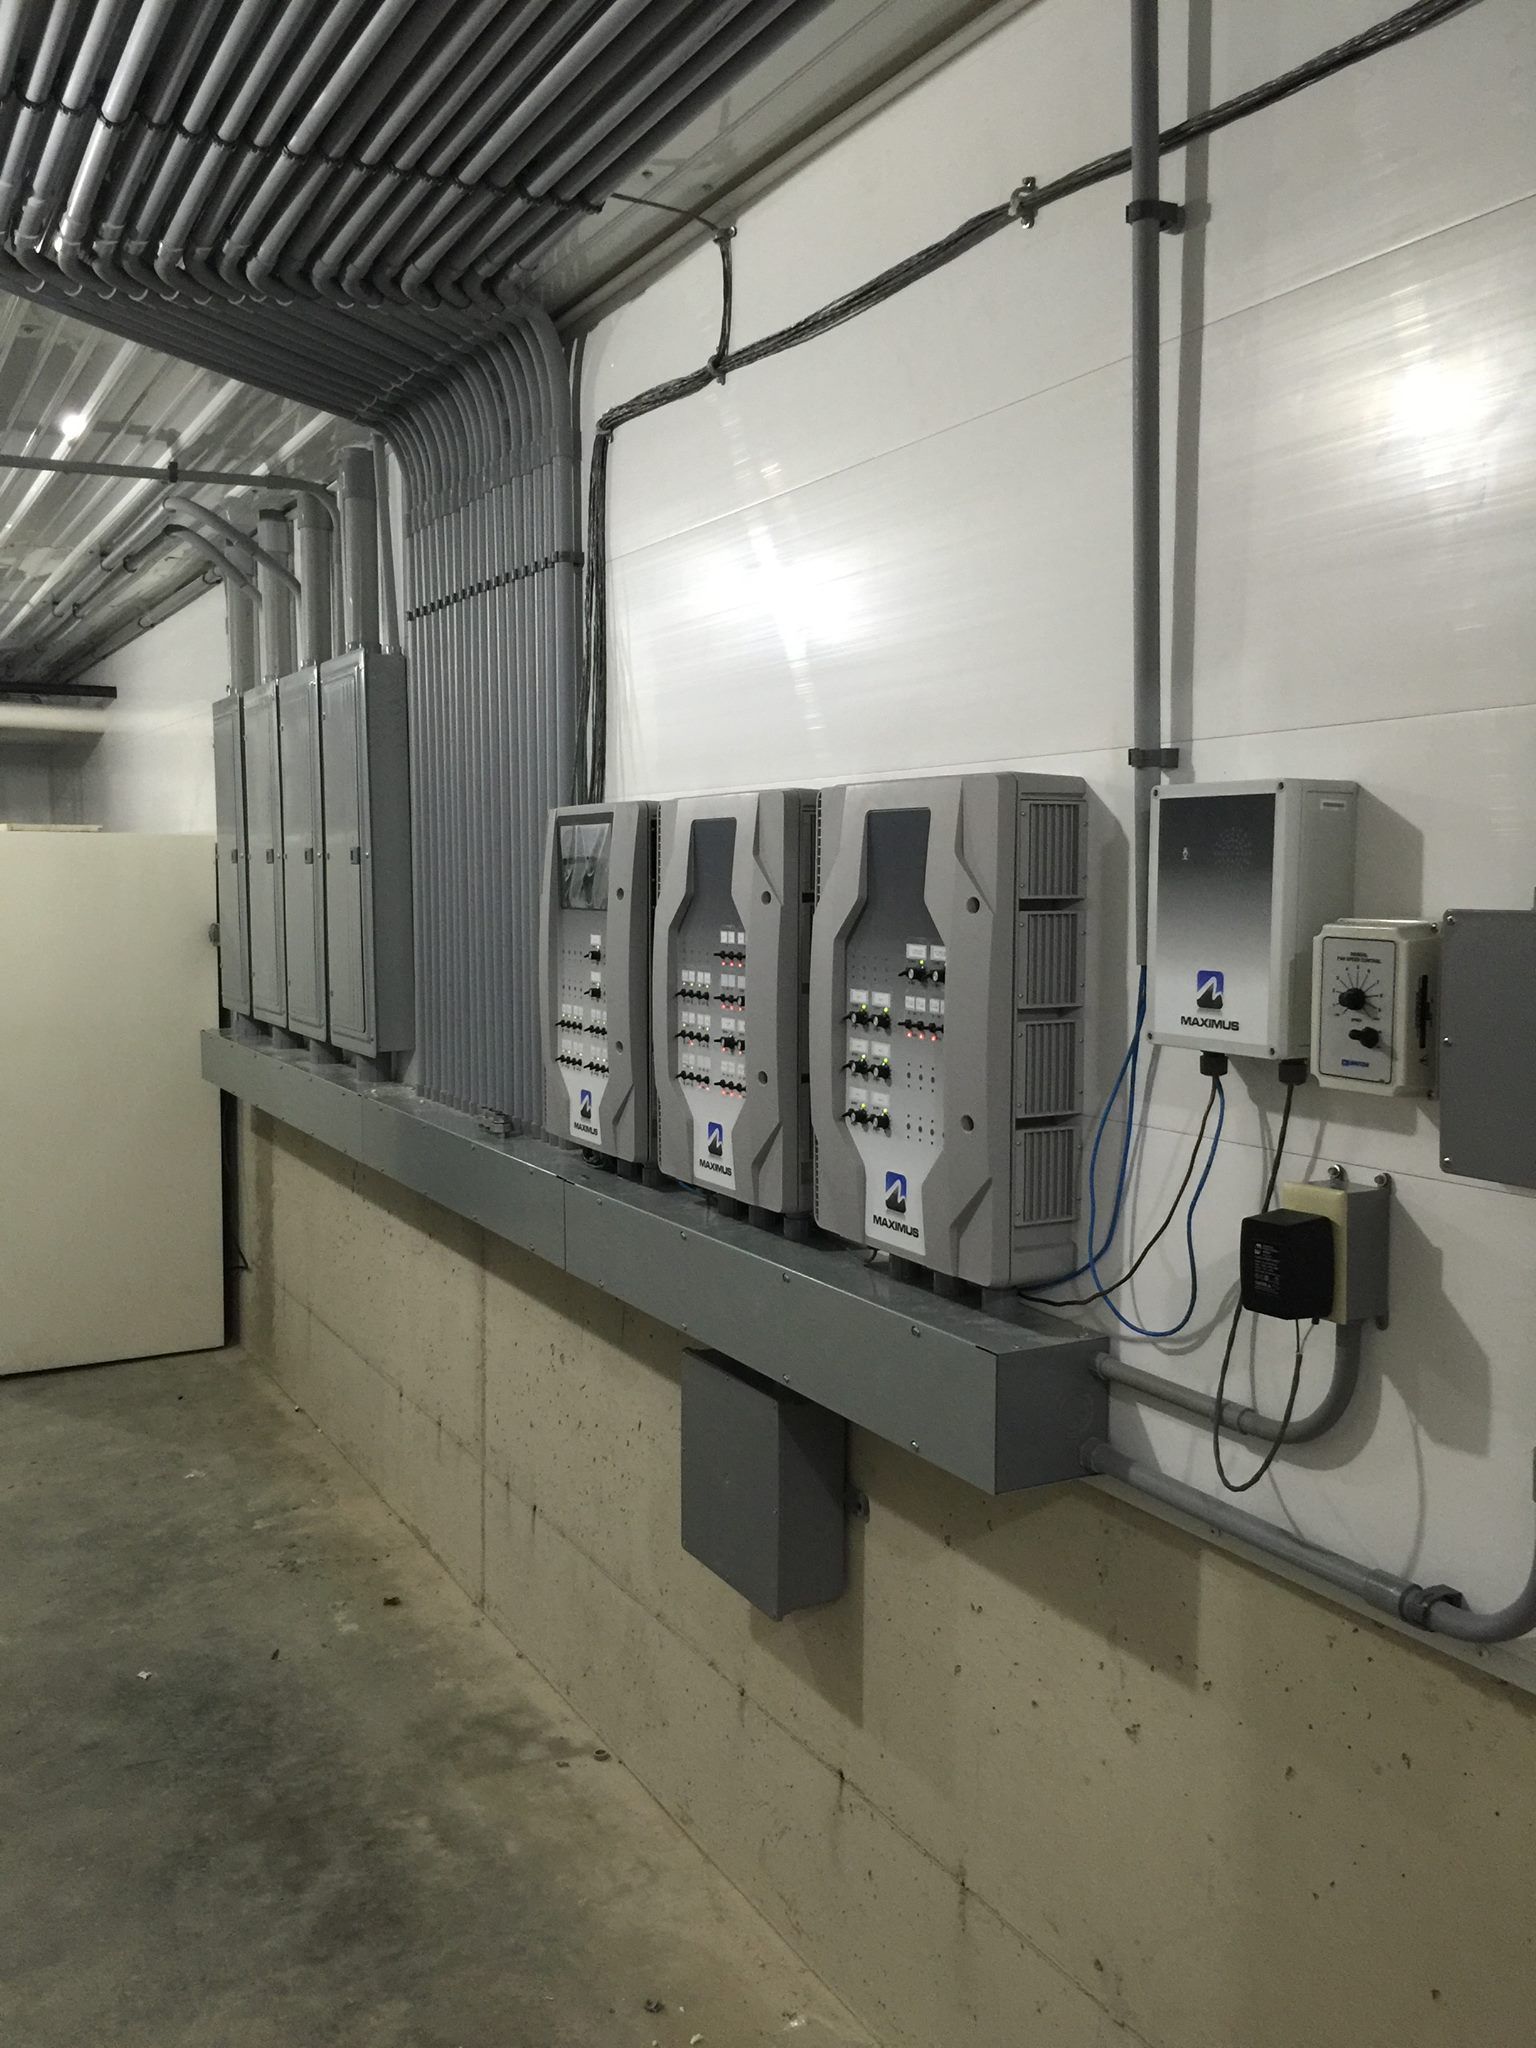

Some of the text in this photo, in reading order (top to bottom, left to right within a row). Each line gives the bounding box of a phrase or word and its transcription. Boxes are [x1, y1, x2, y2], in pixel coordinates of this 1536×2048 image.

[1180, 1015, 1240, 1031] MAXIMUS
[699, 1158, 732, 1177] MAXIMUS
[872, 1214, 919, 1238] MAXIMUS
